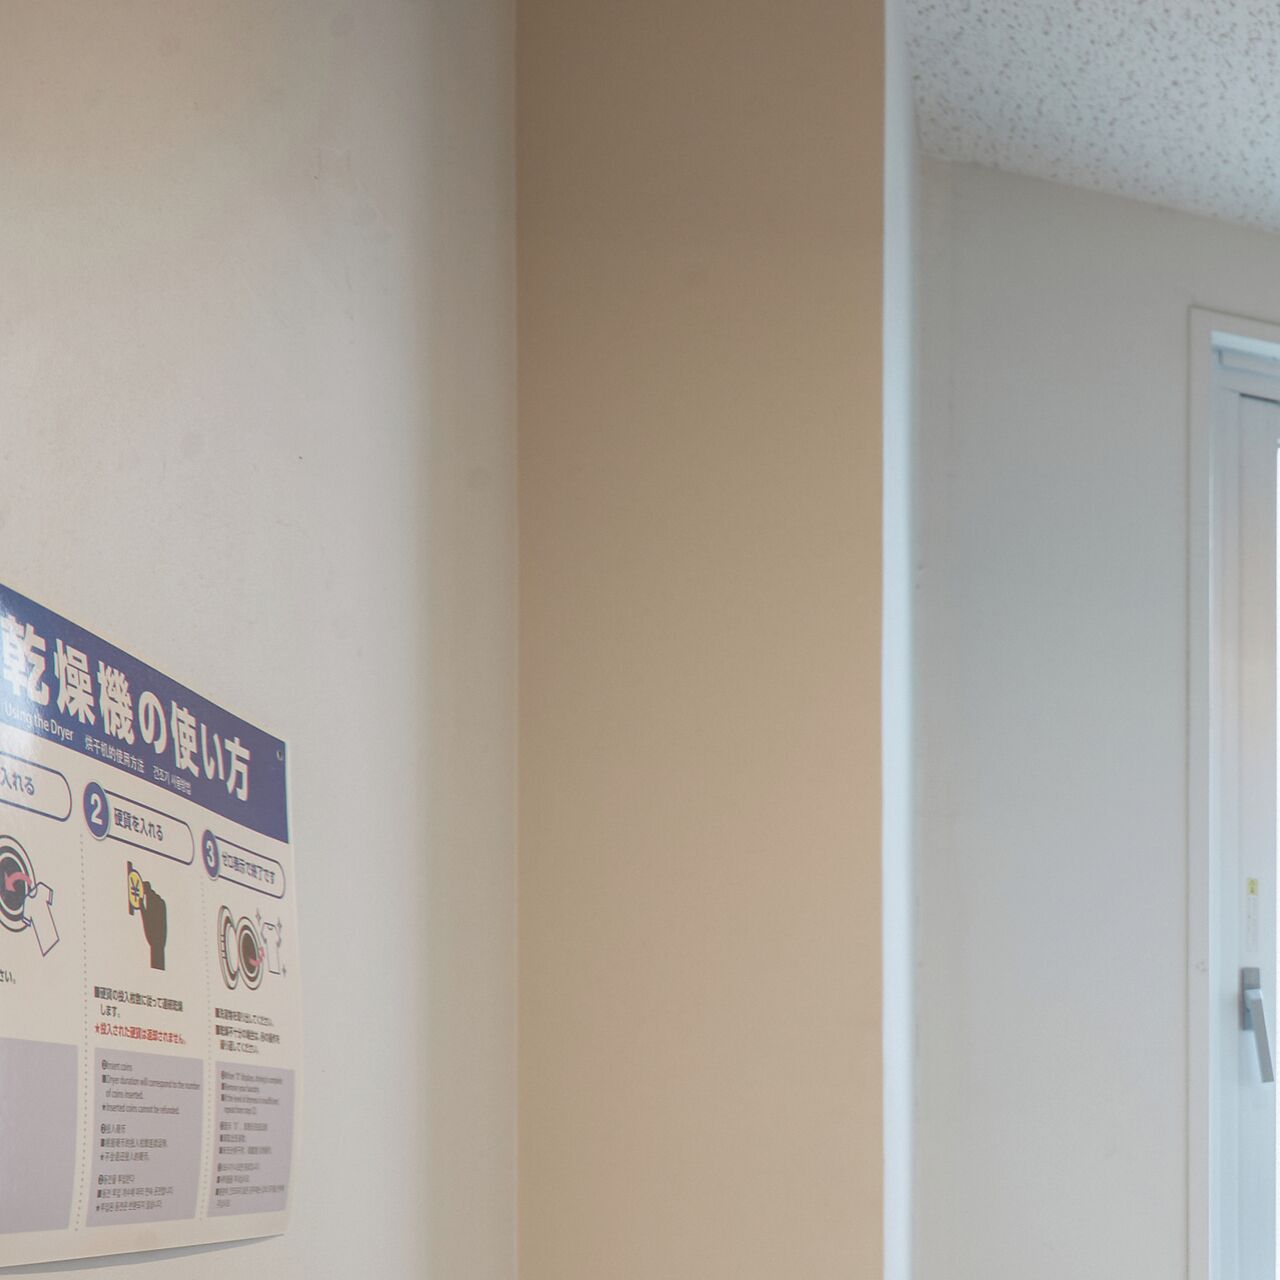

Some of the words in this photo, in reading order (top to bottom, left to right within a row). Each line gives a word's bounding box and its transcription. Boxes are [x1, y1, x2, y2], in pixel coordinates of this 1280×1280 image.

[0, 613, 251, 802] 乾燥機の使い方
[50, 717, 74, 743] Dryer
[90, 792, 104, 826] 2
[113, 806, 165, 842] 硬貨を入れる
[204, 839, 217, 869] 3
